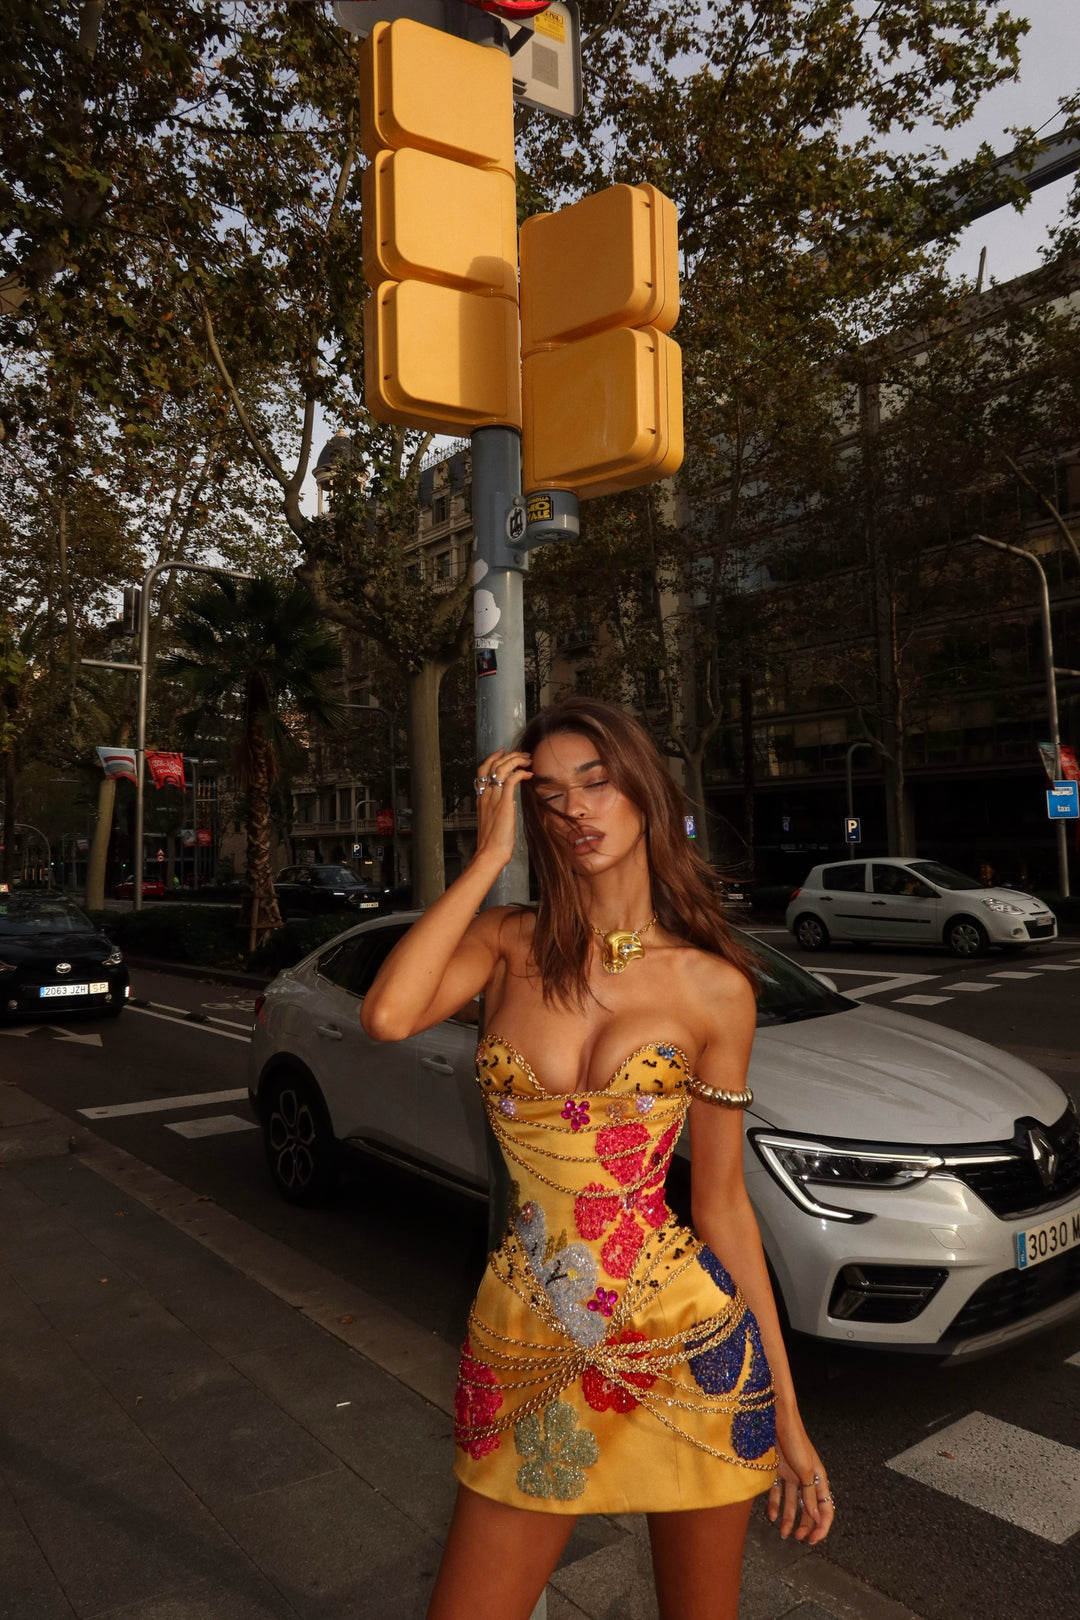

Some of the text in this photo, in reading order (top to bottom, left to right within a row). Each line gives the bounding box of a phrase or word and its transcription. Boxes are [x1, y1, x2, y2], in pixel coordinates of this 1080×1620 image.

[527, 509, 550, 522] VALE
[1057, 804, 1070, 812] taxi
[686, 821, 694, 835] P
[847, 819, 858, 833] P
[354, 844, 360, 852] P
[45, 983, 106, 996] 2063 JZH SP
[1028, 1221, 1068, 1261] 3030
